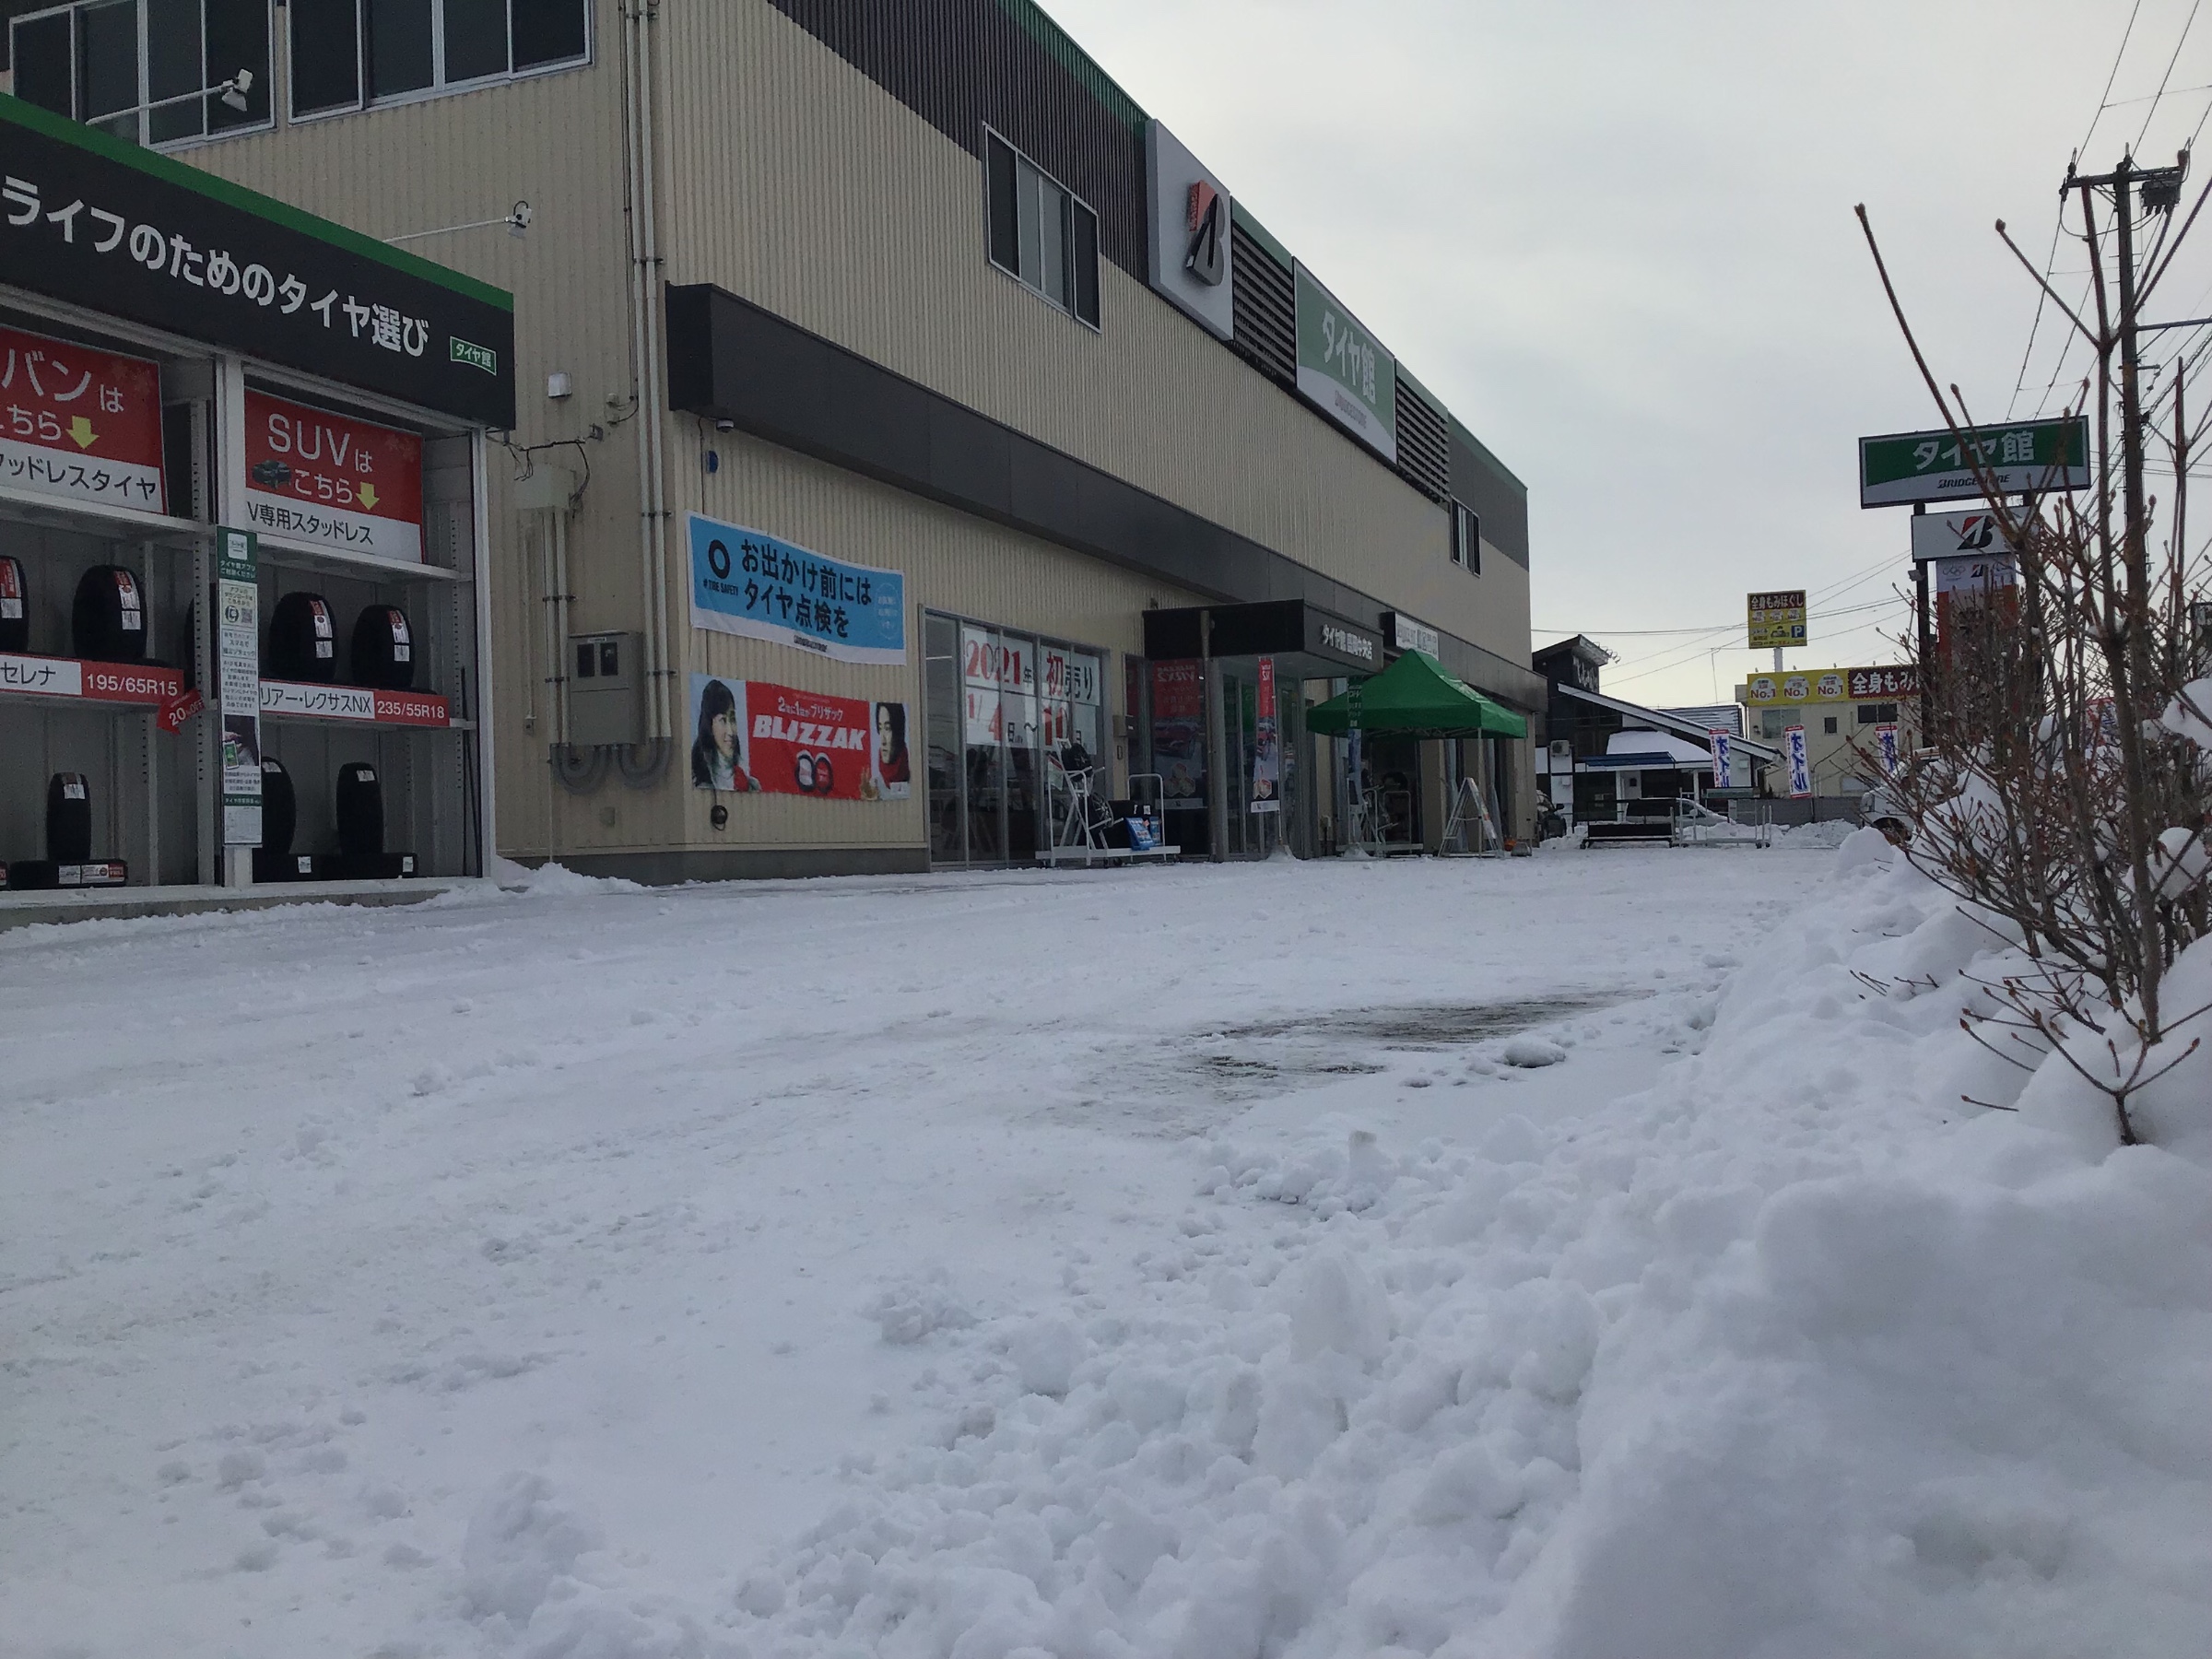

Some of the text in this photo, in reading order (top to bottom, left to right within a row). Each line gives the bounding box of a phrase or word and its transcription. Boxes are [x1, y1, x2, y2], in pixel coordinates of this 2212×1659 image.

[2, 176, 429, 357] ライフのためのタイヤ選び
[455, 343, 491, 367] タイヤ館
[1323, 310, 1376, 405] タイヤ館
[0, 404, 62, 441] ちら
[1912, 430, 2034, 471] タイヤ館
[0, 453, 156, 500] ッドレスタイヤ
[295, 468, 353, 504] こちら
[741, 539, 872, 606] お出かけ前には
[744, 578, 849, 638] タイヤ点検を
[1751, 594, 1803, 609] 全身もみほぐし
[88, 674, 177, 696] 195/65R15
[1751, 688, 1776, 699] No.1
[1784, 687, 1809, 697] No.1
[1818, 685, 1843, 695] No.1
[377, 700, 445, 718] 235/55R18
[753, 714, 866, 750] BLIZZAK
[1791, 733, 1808, 792] オイル
